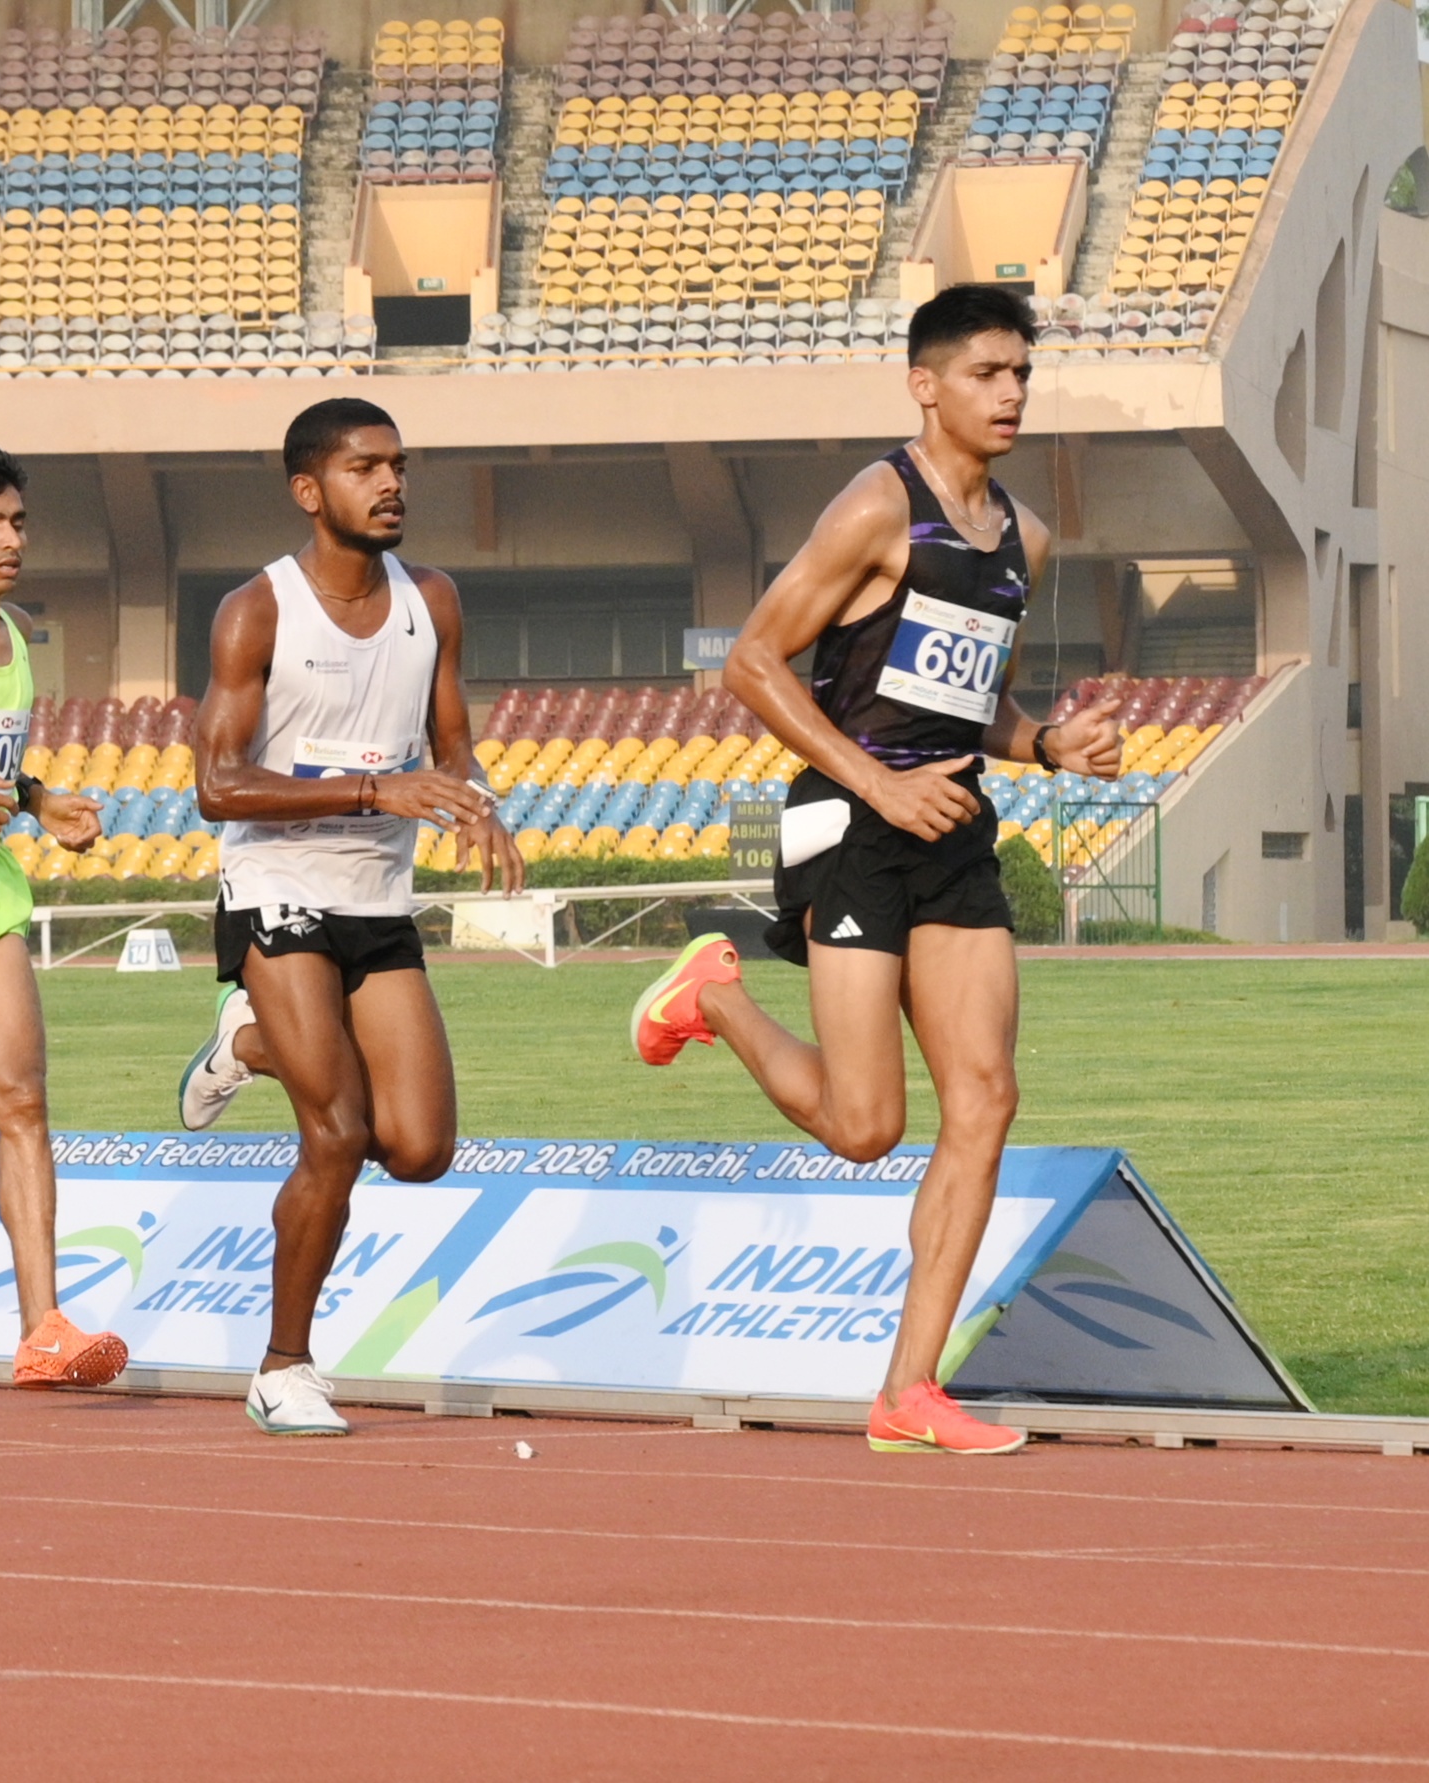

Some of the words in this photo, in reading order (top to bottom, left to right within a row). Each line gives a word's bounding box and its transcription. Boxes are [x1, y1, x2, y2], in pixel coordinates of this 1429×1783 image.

[1003, 266, 1017, 275] EXIT
[914, 630, 999, 694] 690
[737, 803, 773, 816] MENS
[731, 824, 780, 839] ABHIJIT
[733, 848, 773, 868] 106
[521, 1142, 618, 1182] 2026,
[617, 1143, 758, 1185] Ranchi,
[753, 1146, 931, 1183] Jharkhan
[660, 1302, 901, 1345] ATHLETICS
